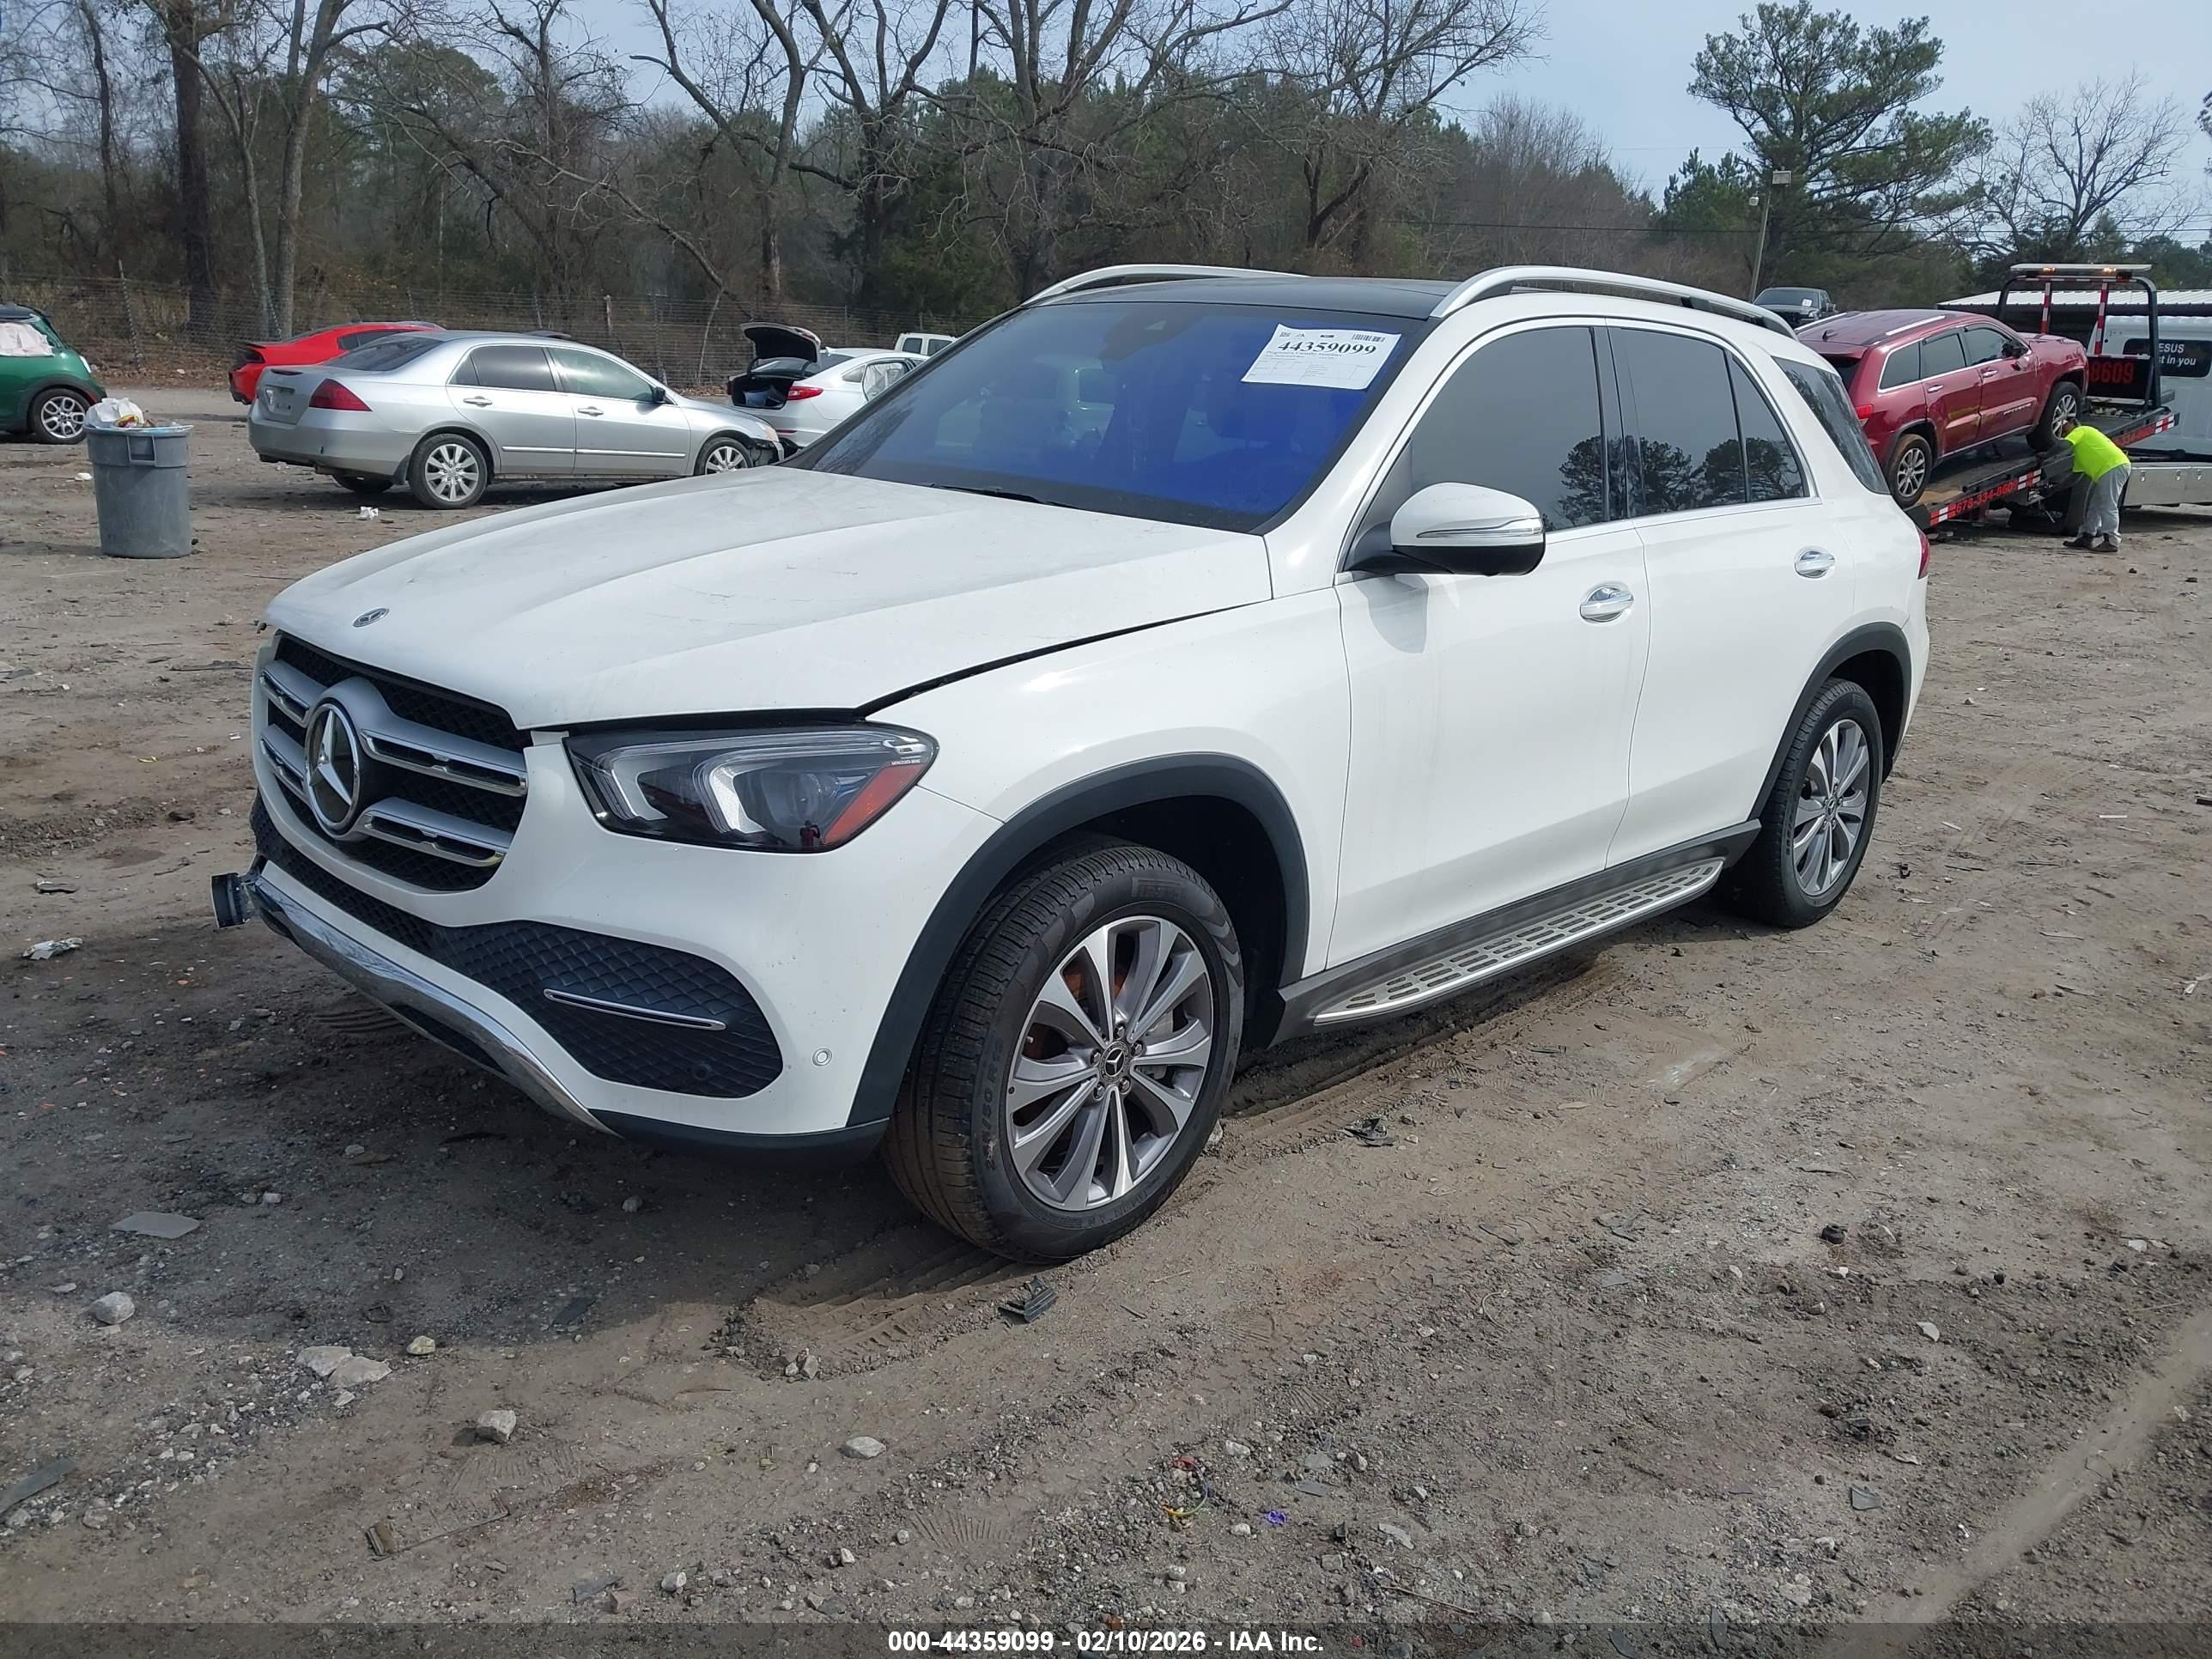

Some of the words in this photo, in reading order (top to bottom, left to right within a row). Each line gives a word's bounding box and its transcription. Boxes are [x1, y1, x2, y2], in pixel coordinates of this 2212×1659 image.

[1278, 341, 1376, 356] 44359099
[2158, 343, 2185, 354] ESUS
[2166, 355, 2176, 364] in
[2178, 357, 2197, 368] you
